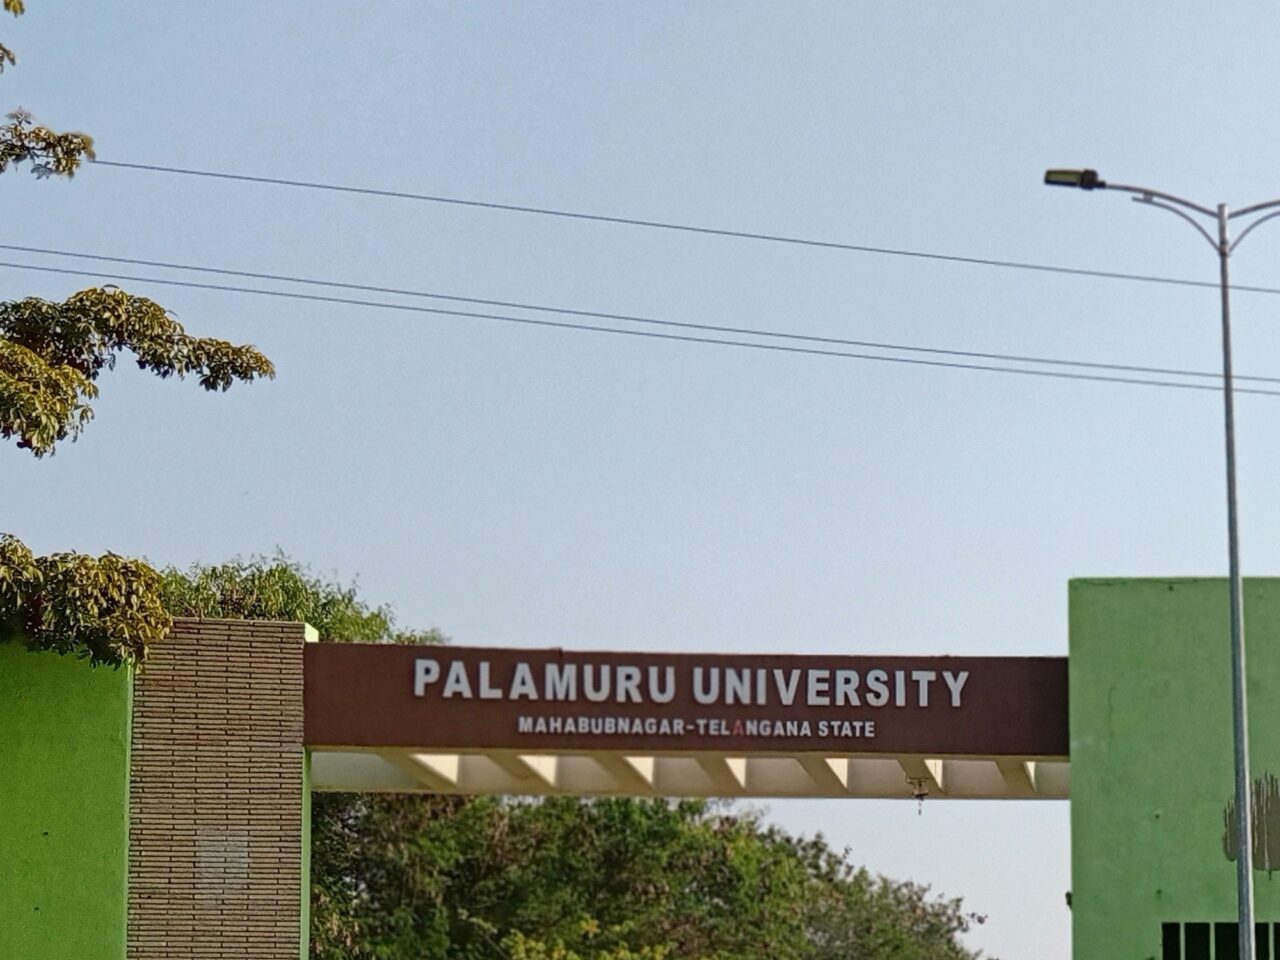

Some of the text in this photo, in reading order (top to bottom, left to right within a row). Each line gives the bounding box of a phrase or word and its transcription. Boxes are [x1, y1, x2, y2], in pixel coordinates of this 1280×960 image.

[414, 658, 971, 709] PALAMURU UNIVERSITY
[817, 719, 877, 738] STATE
